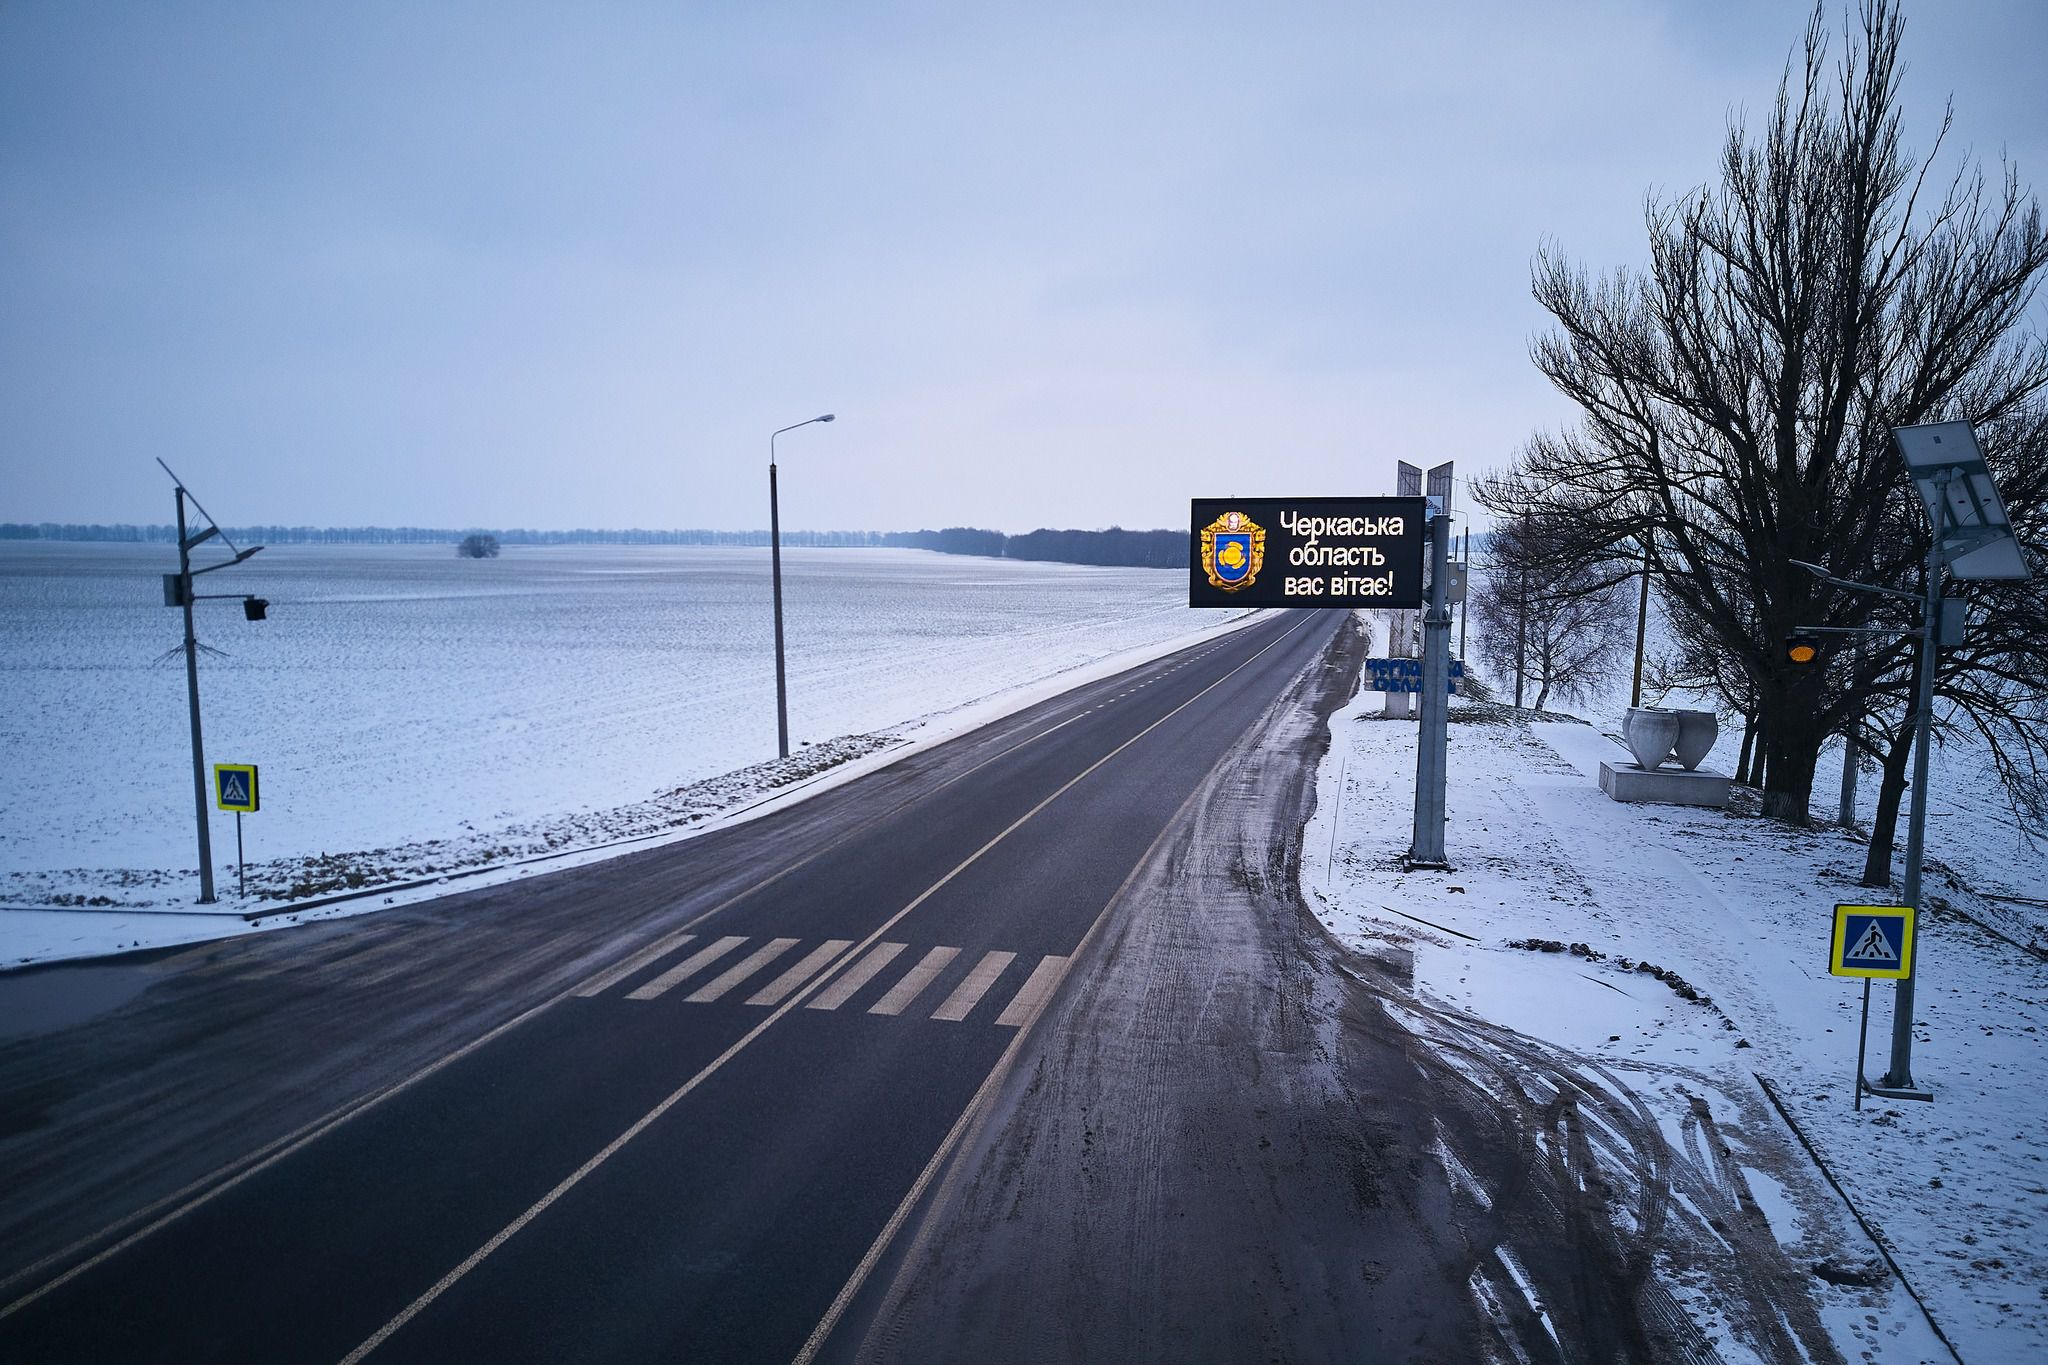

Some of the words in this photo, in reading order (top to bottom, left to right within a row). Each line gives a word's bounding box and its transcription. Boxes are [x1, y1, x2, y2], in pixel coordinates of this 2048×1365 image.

[1279, 510, 1404, 543] Черкаська
[1289, 539, 1385, 566] область
[1284, 576, 1324, 596] вас
[1330, 570, 1394, 596] вітає!
